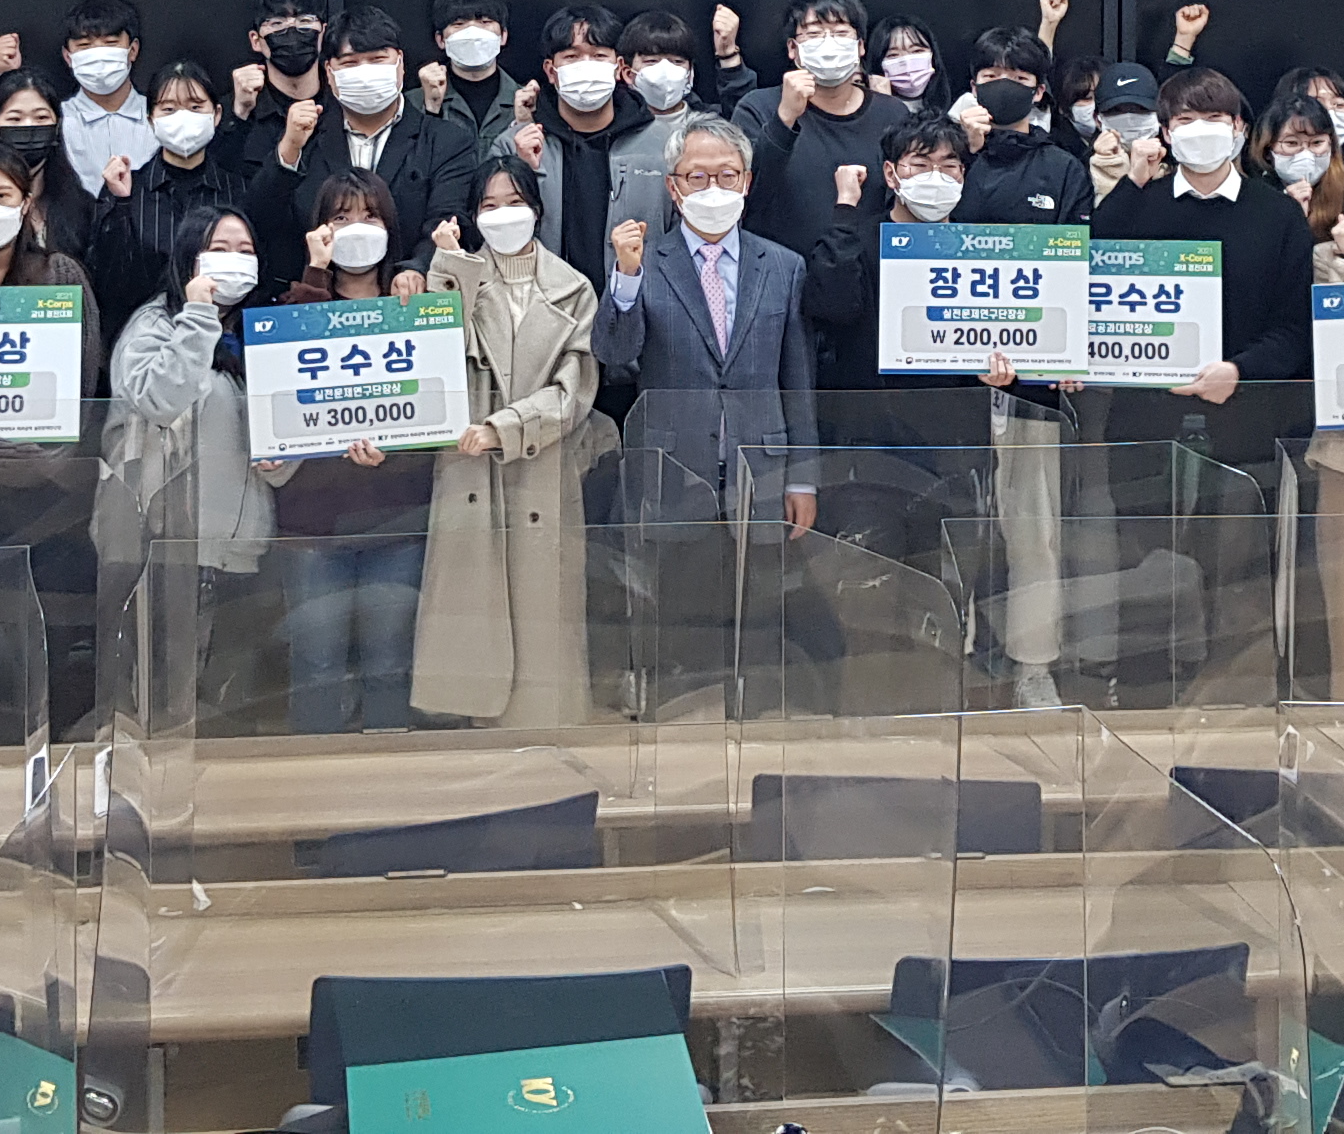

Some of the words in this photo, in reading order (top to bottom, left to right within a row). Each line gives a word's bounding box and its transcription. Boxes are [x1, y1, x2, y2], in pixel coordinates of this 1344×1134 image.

[929, 266, 1043, 300] 장려상
[942, 307, 1026, 321] 실전문제연구단장상
[953, 327, 1038, 349] 200,000
[297, 338, 416, 382] 우수상
[314, 382, 403, 402] 실전문제연구단장상
[326, 401, 416, 428] 300,000
